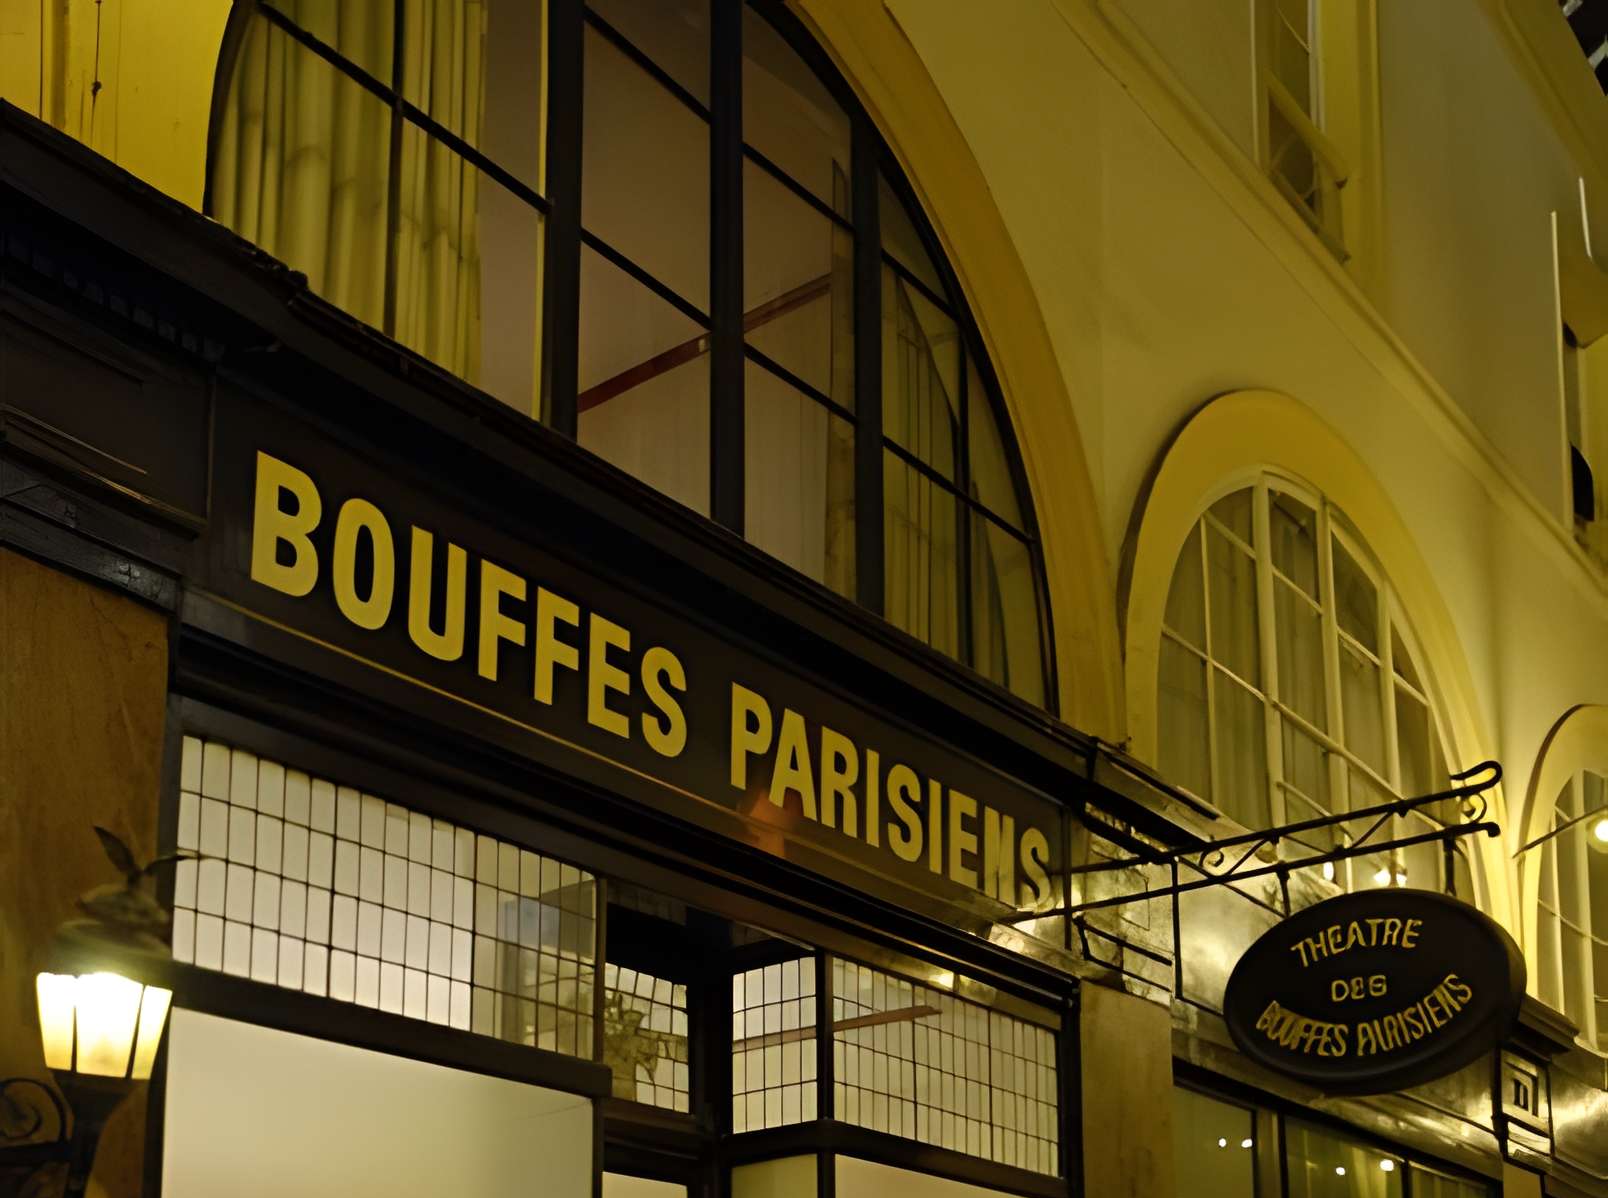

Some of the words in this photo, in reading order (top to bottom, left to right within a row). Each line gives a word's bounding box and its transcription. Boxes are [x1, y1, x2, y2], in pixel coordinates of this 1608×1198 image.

[250, 448, 688, 758] BOUFFES
[730, 680, 1052, 913] PARISIENS
[1290, 918, 1423, 967] THEATRE
[1256, 1000, 1349, 1057] BOUFFES
